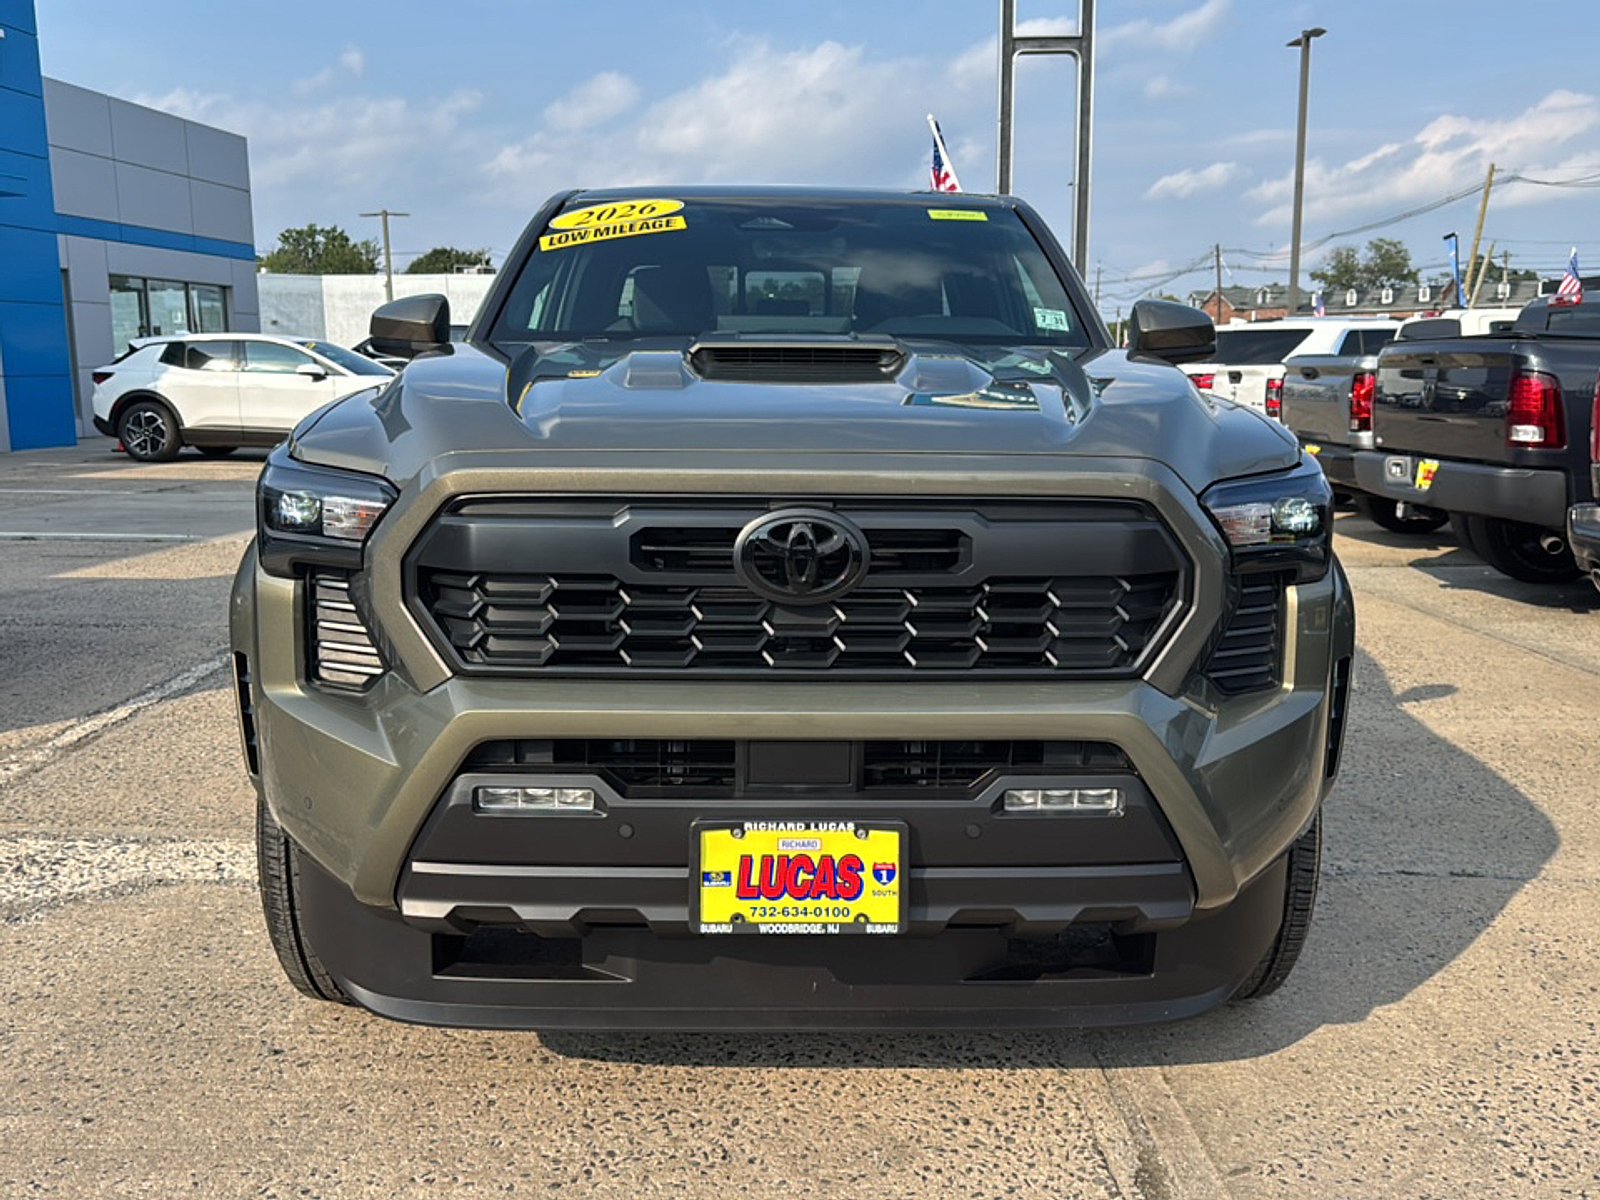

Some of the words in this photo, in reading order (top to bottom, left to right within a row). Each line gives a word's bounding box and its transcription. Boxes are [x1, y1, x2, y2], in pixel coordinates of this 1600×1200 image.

[574, 203, 657, 226] 2026
[548, 229, 590, 247] LOW
[593, 218, 677, 238] MILEAGE
[743, 821, 806, 831] RICHARD
[810, 821, 855, 831] LUCAS
[781, 839, 818, 848] RICHARD
[736, 854, 865, 900] LUCAS
[880, 869, 889, 883] 1
[872, 889, 898, 897] SOUTH
[749, 906, 850, 918] 732-634-0100
[700, 923, 733, 934] SUBARU
[827, 923, 840, 934] NJ
[866, 923, 898, 934] SUBARU
